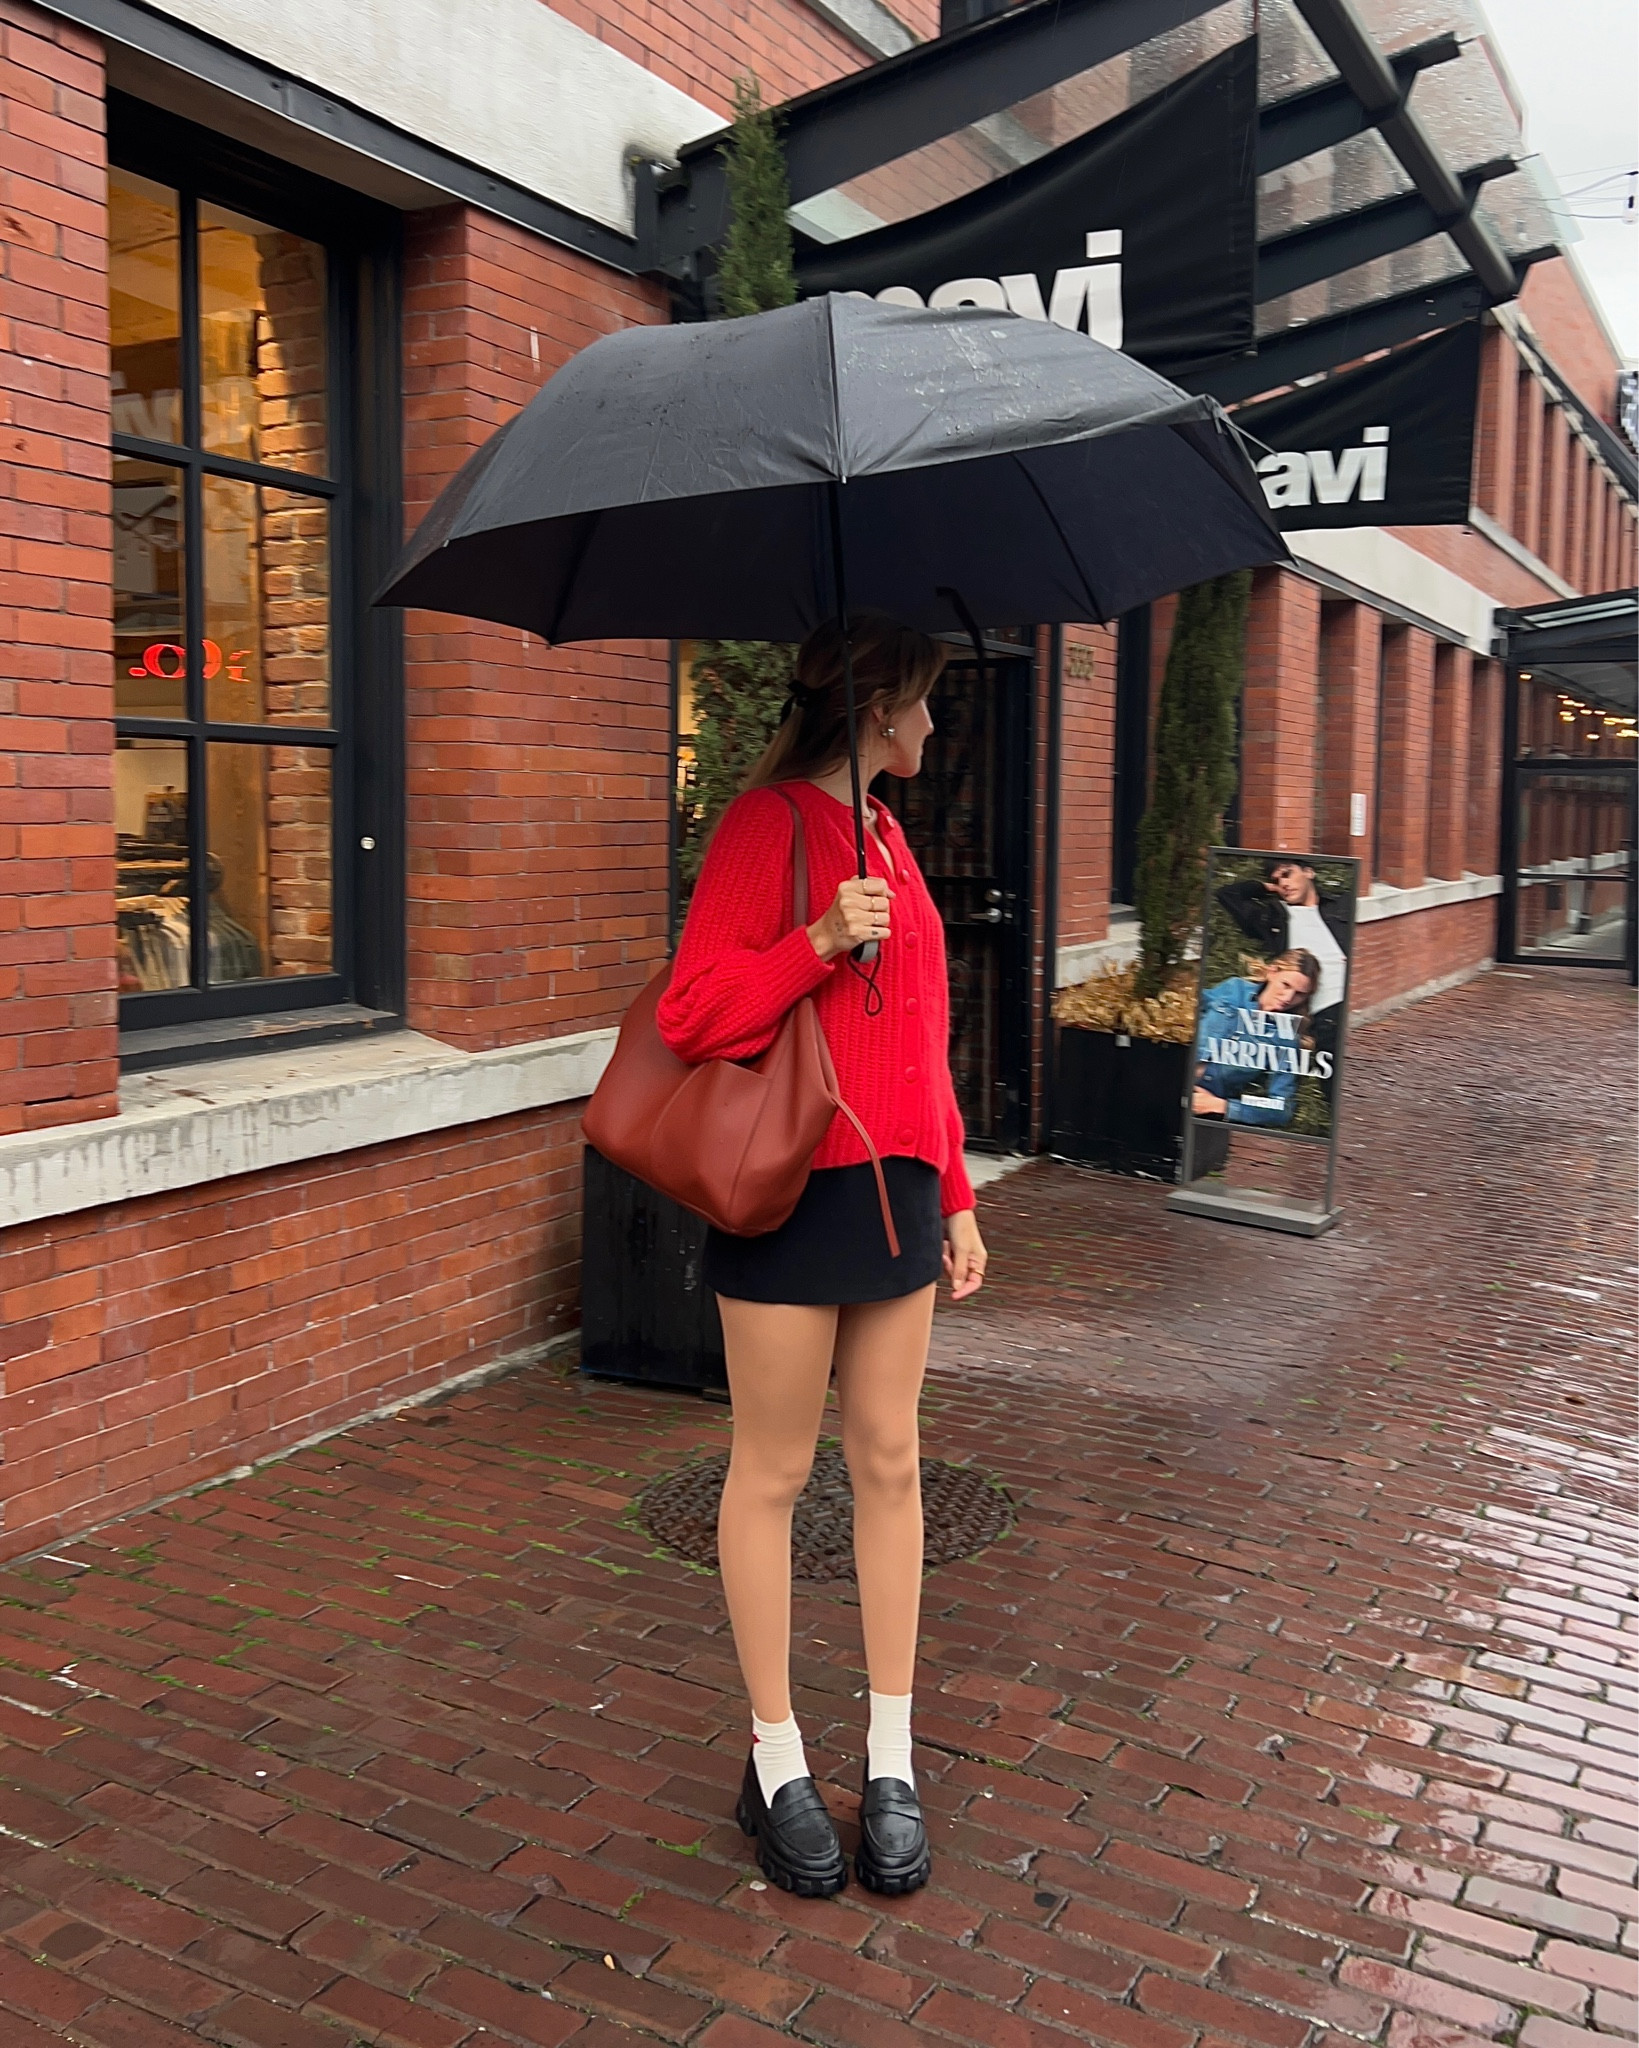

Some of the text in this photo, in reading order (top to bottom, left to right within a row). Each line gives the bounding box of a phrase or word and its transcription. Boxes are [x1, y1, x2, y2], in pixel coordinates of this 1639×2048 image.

[843, 229, 1123, 350] vi
[1235, 1007, 1304, 1042] NEW
[1199, 1036, 1334, 1080] ARRIVALS
